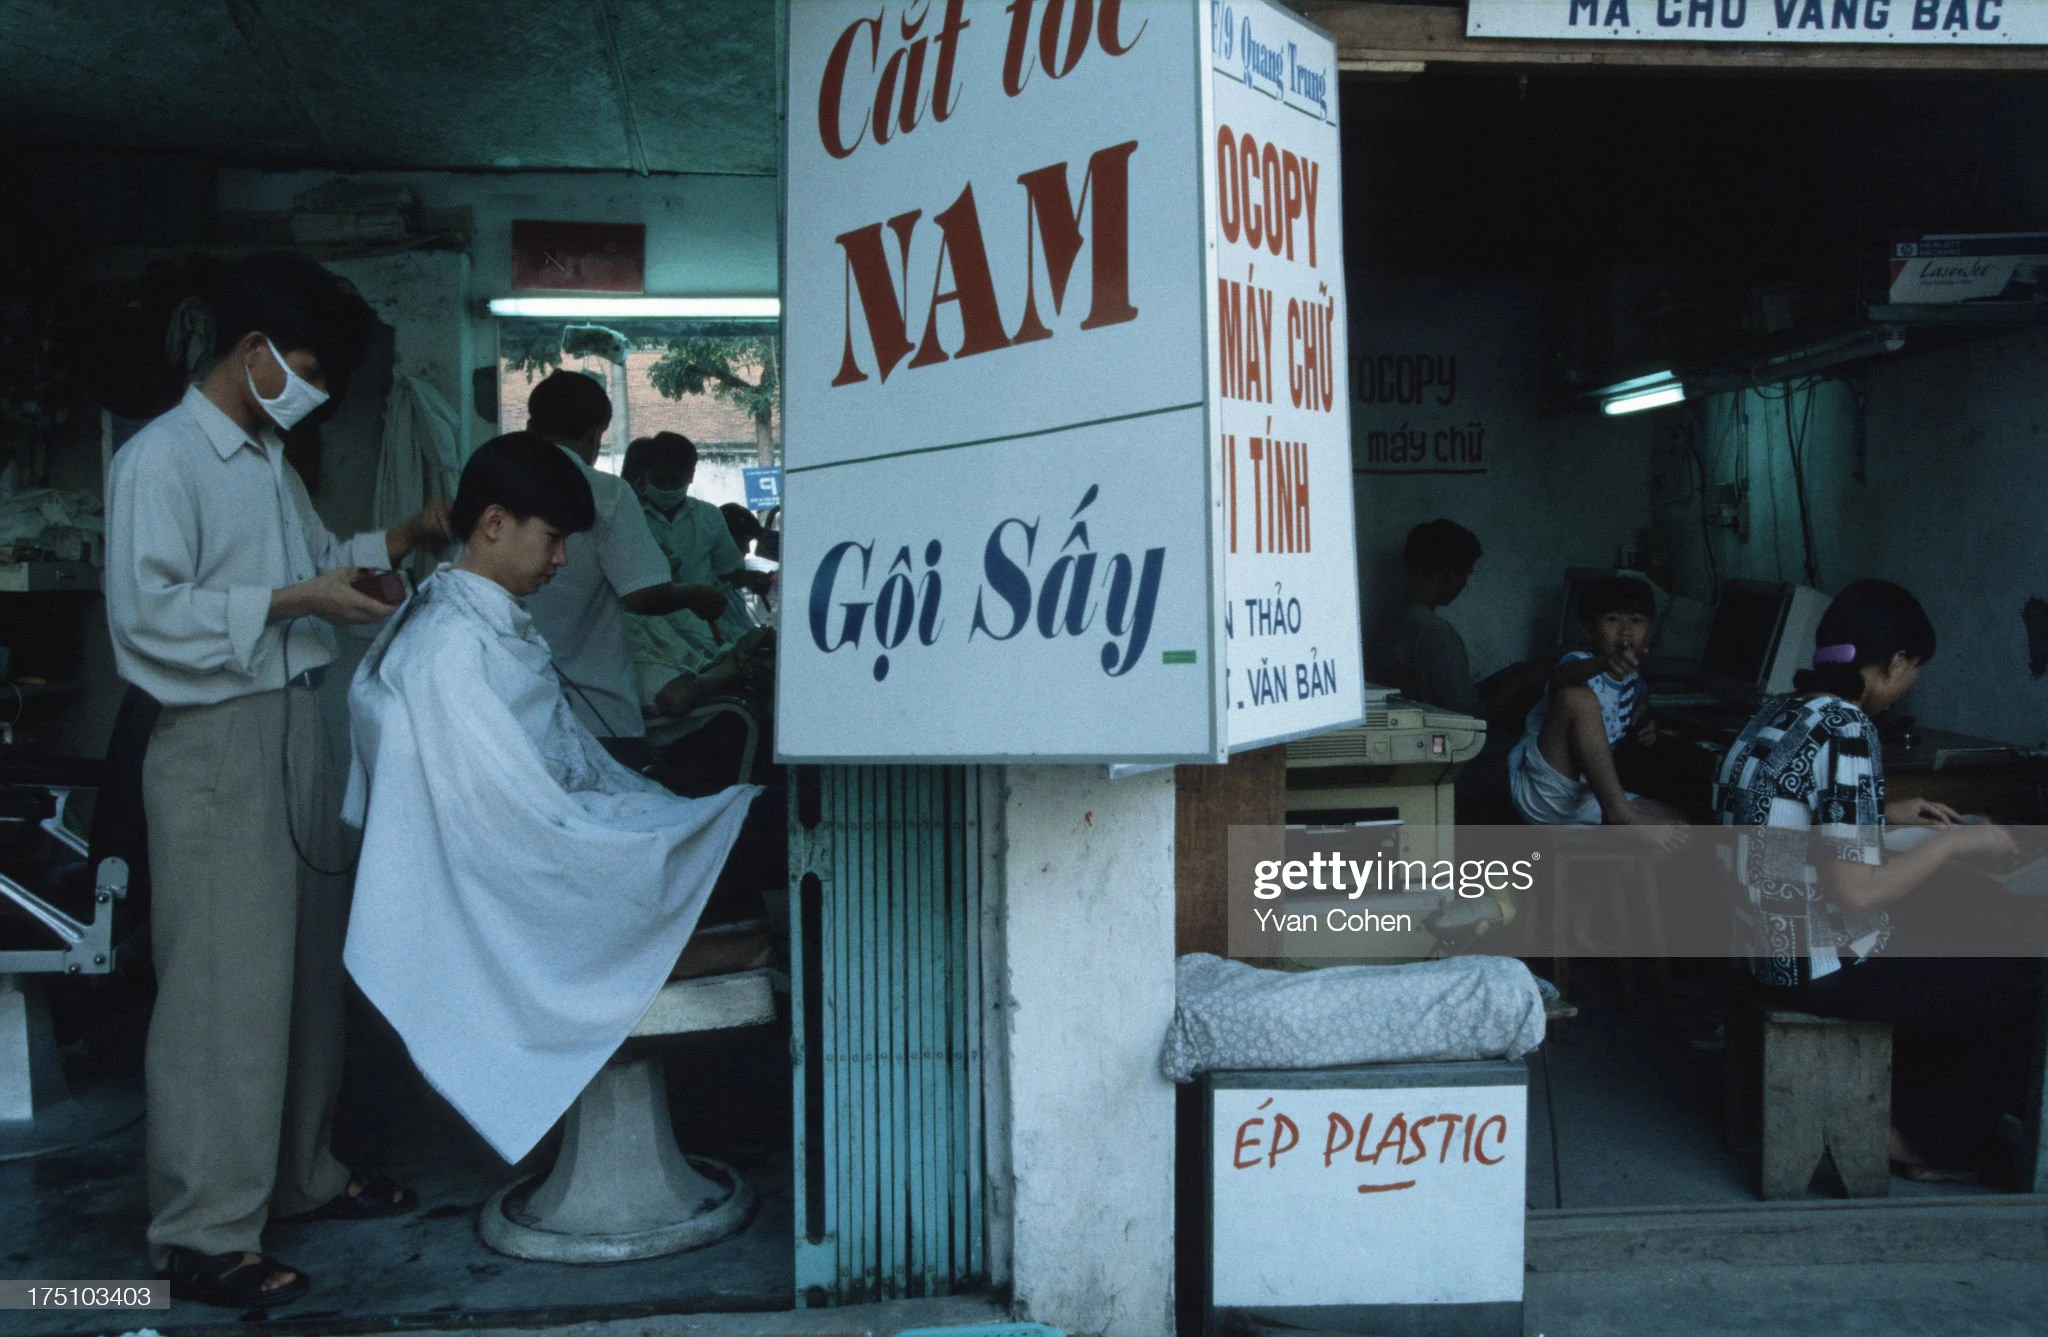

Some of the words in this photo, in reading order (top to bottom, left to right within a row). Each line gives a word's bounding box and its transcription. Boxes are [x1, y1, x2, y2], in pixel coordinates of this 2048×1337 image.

[1241, 16, 1284, 101] Quang
[1288, 42, 1327, 121] Trung
[1217, 124, 1319, 268] OCOPY
[831, 140, 1138, 388] NAM
[1218, 263, 1272, 404] MÁY
[1288, 281, 1334, 413] CHỮ
[1250, 416, 1311, 554] TÍNH
[1368, 422, 1426, 463] máy
[1434, 421, 1485, 463] chữ
[809, 538, 944, 682] Gọi
[968, 483, 1166, 677] Sấy
[1245, 581, 1302, 637] THẢO
[1296, 646, 1337, 700] BẢN
[1233, 1097, 1300, 1169] ÉP
[1323, 1112, 1508, 1168] PLASTIC
